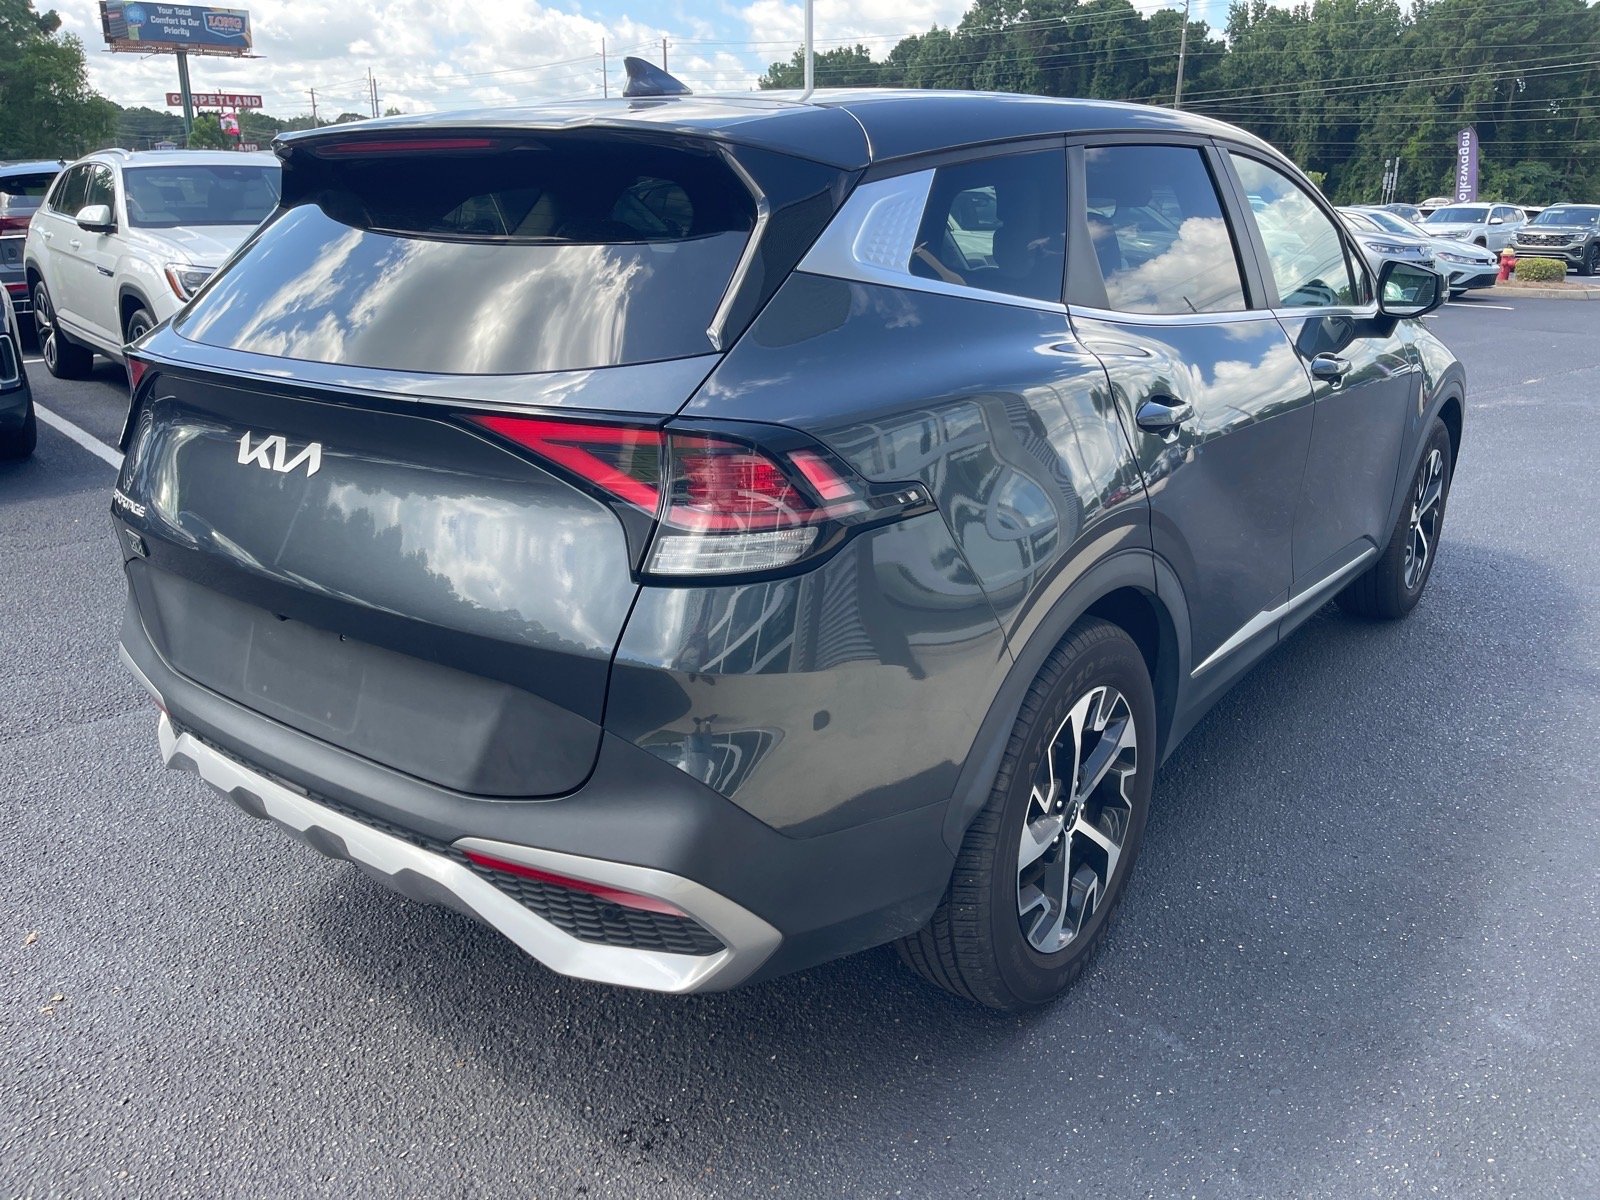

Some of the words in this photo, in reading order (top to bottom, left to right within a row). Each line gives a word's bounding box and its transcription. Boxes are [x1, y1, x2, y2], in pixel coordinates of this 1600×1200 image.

[157, 6, 173, 14] Your
[174, 7, 192, 16] Total
[150, 15, 179, 25] Comfort
[180, 17, 187, 25] is
[187, 18, 200, 26] Our
[163, 26, 190, 37] Priority
[171, 94, 260, 106] CRPETLAND
[237, 430, 322, 478] KIA
